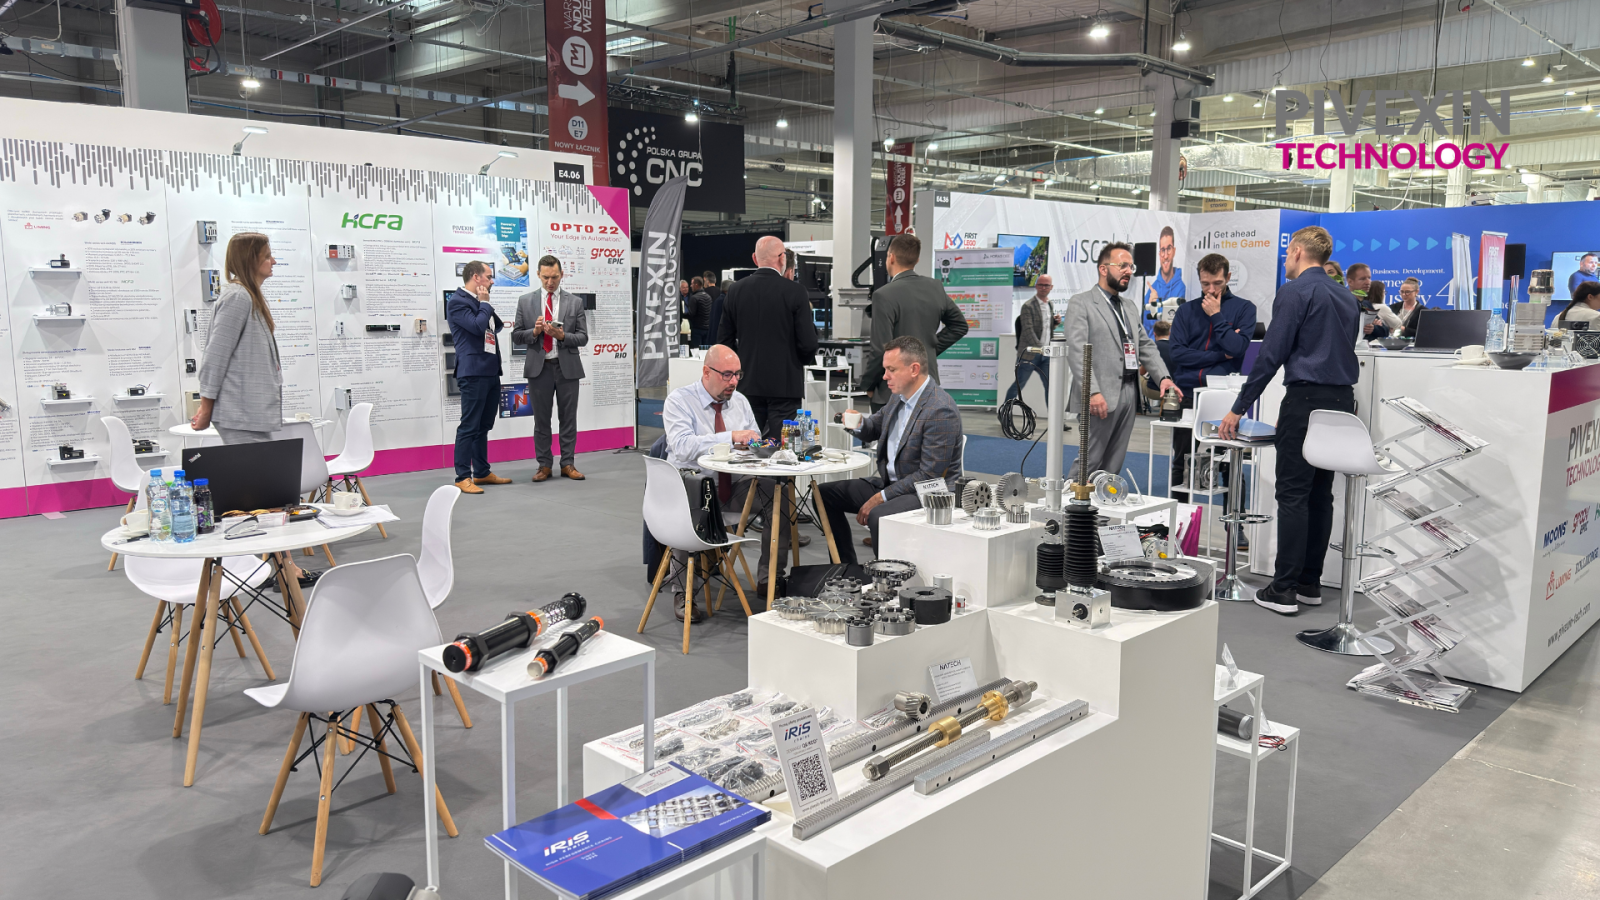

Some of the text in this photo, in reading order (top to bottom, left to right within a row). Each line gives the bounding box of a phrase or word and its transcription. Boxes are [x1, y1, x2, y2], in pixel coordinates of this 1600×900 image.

[582, 0, 592, 33] WEE
[571, 119, 585, 129] D11
[574, 129, 584, 139] E7
[554, 141, 601, 154] NOWY ŁĄCZNIK
[646, 146, 702, 160] POLSKA GRUPA
[558, 169, 581, 180] E4.06
[646, 157, 704, 187] CNC
[550, 222, 619, 235] OPTO 22
[1213, 229, 1256, 239] Get ahead
[964, 232, 978, 240] FIRST
[963, 239, 977, 247] LEGO
[1221, 240, 1238, 249] the
[1240, 239, 1271, 248] Game
[590, 247, 625, 260] groov
[607, 257, 625, 265] EPIC
[1402, 268, 1446, 276] Development.
[642, 231, 668, 360] PIVEXIN
[593, 343, 628, 356] groov
[1567, 417, 1600, 463] PIVEX
[939, 659, 962, 671] NATECH
[562, 839, 591, 854] chains
